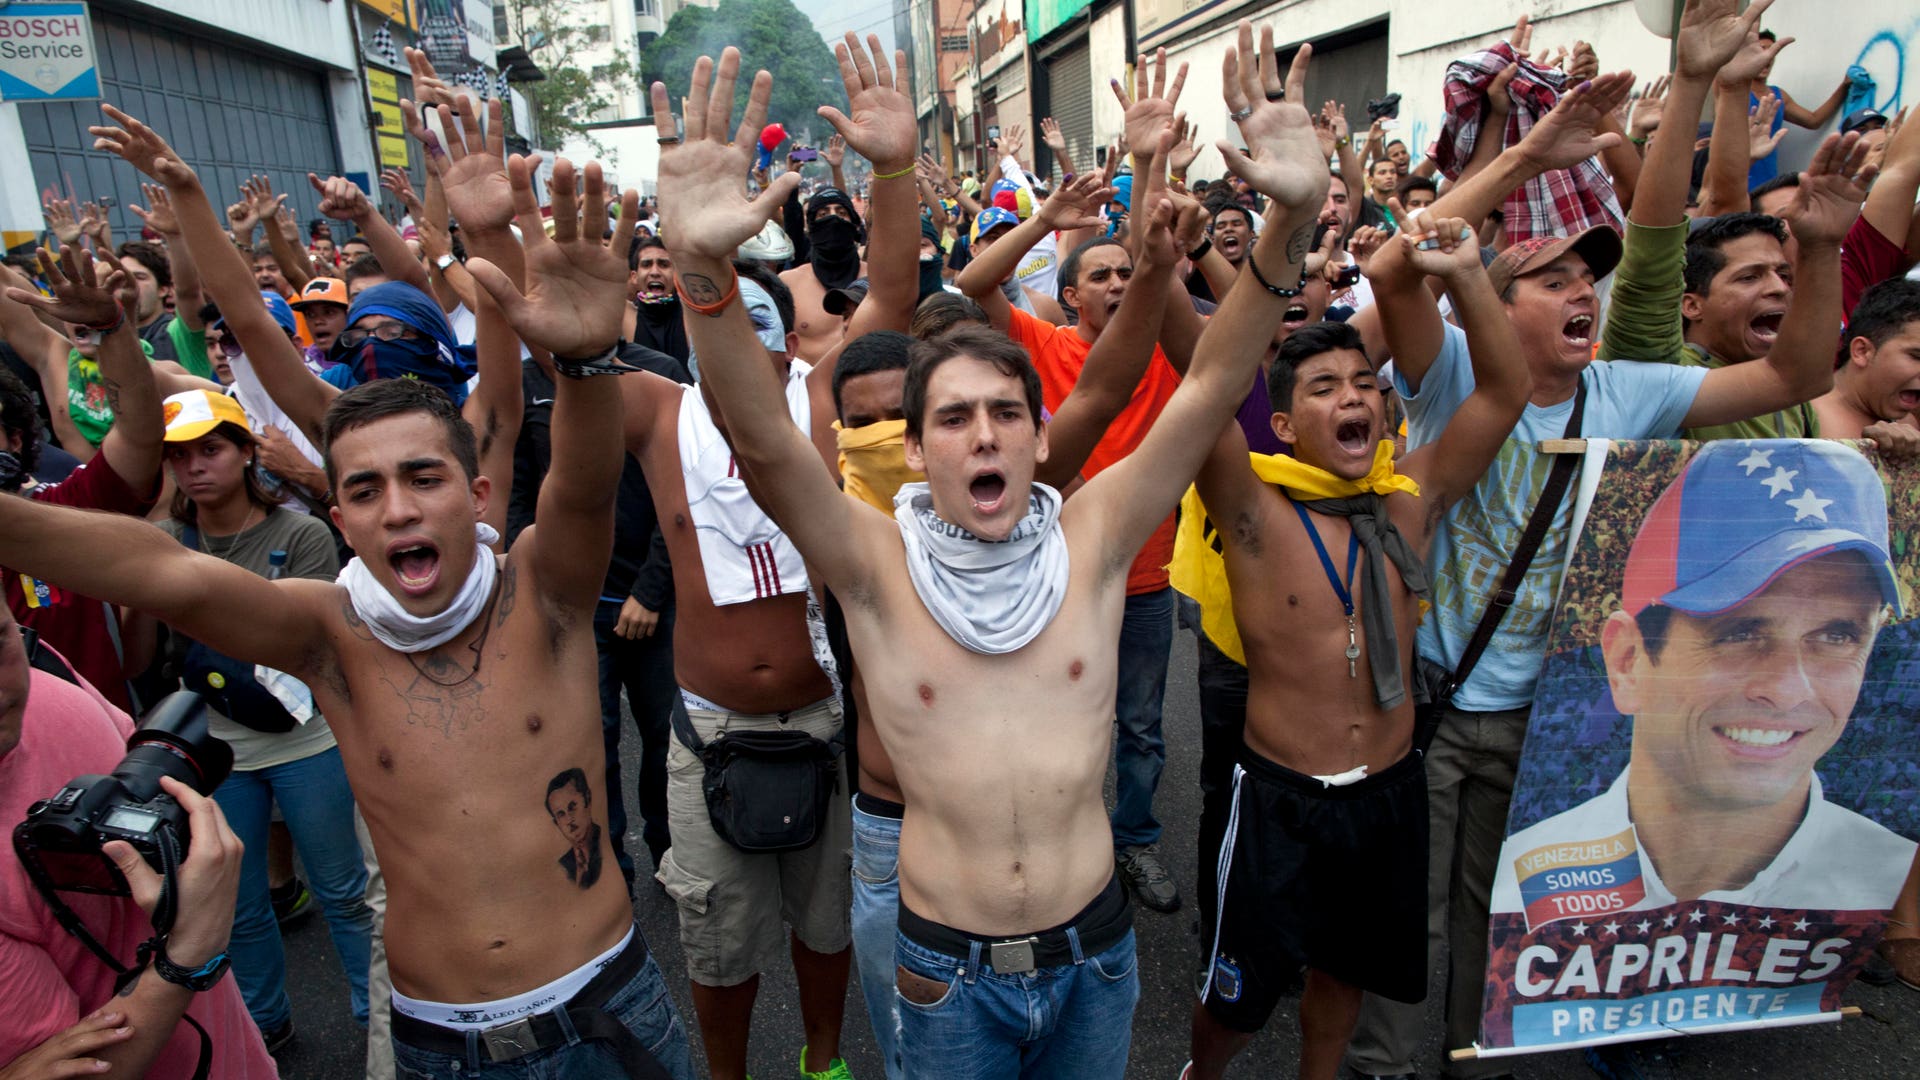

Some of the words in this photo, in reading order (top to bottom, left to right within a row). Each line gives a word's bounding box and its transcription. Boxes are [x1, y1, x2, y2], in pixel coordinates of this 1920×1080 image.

[0, 18, 80, 38] BOSCH
[1, 41, 83, 59] Service
[1521, 840, 1627, 872] VENEZUELA
[1545, 868, 1616, 890] SOMOS
[1551, 892, 1624, 915] TODOS
[1514, 932, 1851, 997] CAPRILES
[1552, 993, 1790, 1037] PRESIDENTE
